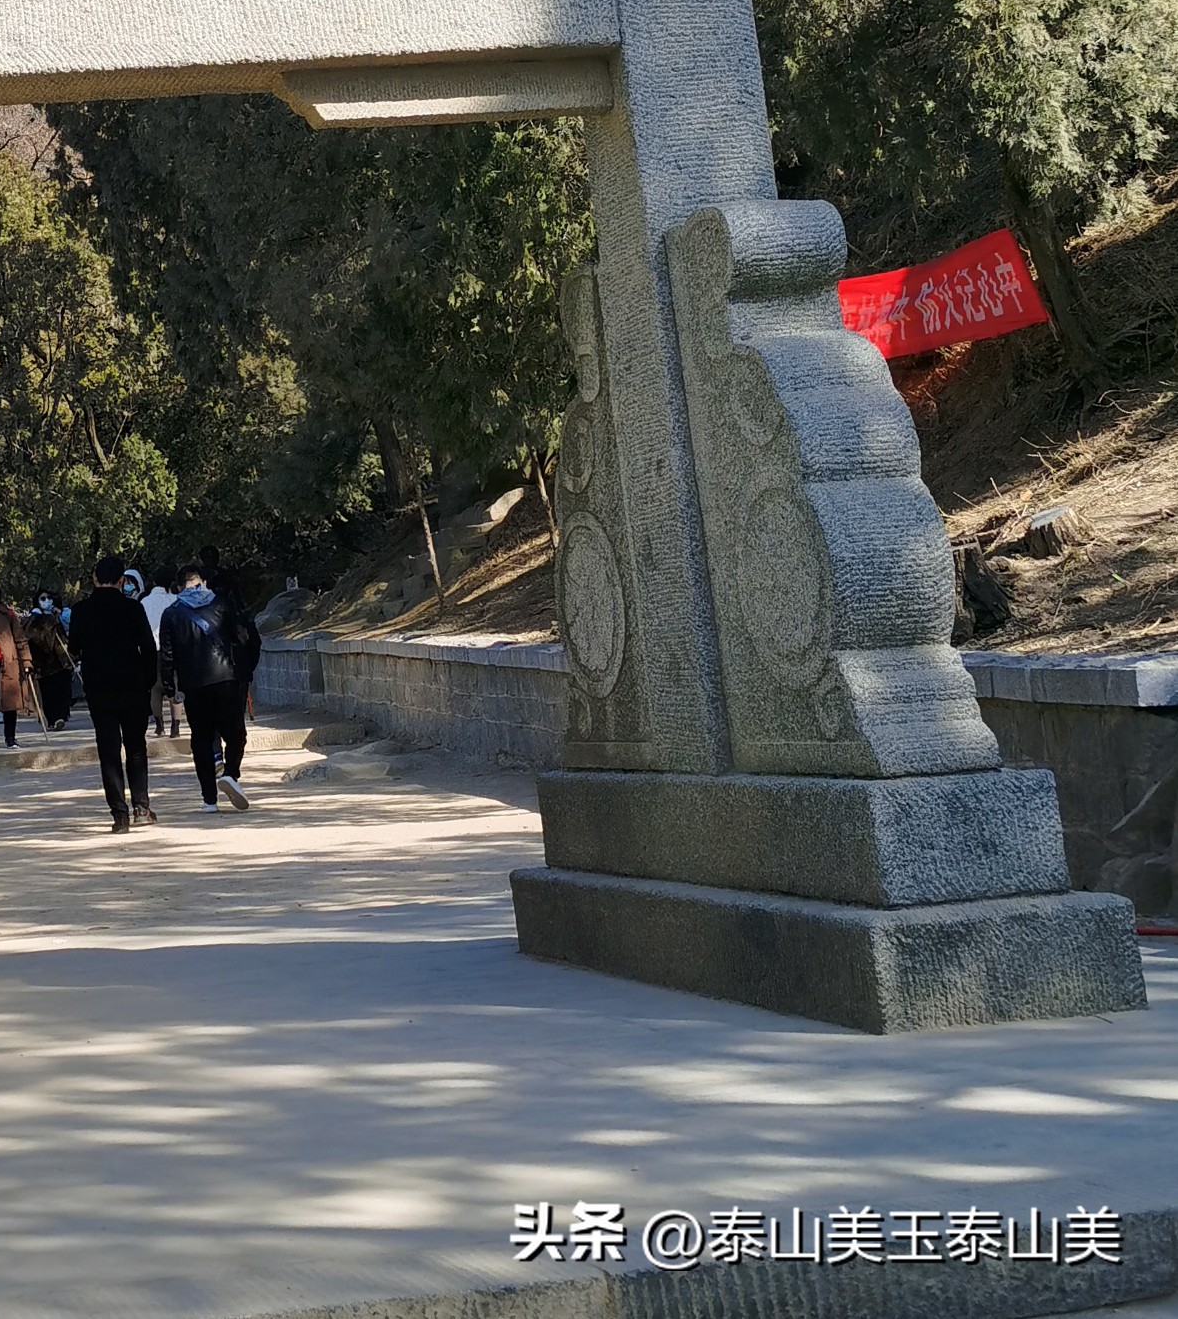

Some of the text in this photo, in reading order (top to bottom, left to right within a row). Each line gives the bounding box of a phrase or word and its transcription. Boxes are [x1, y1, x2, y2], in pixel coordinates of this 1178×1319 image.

[914, 252, 1022, 335] 防火记心中
